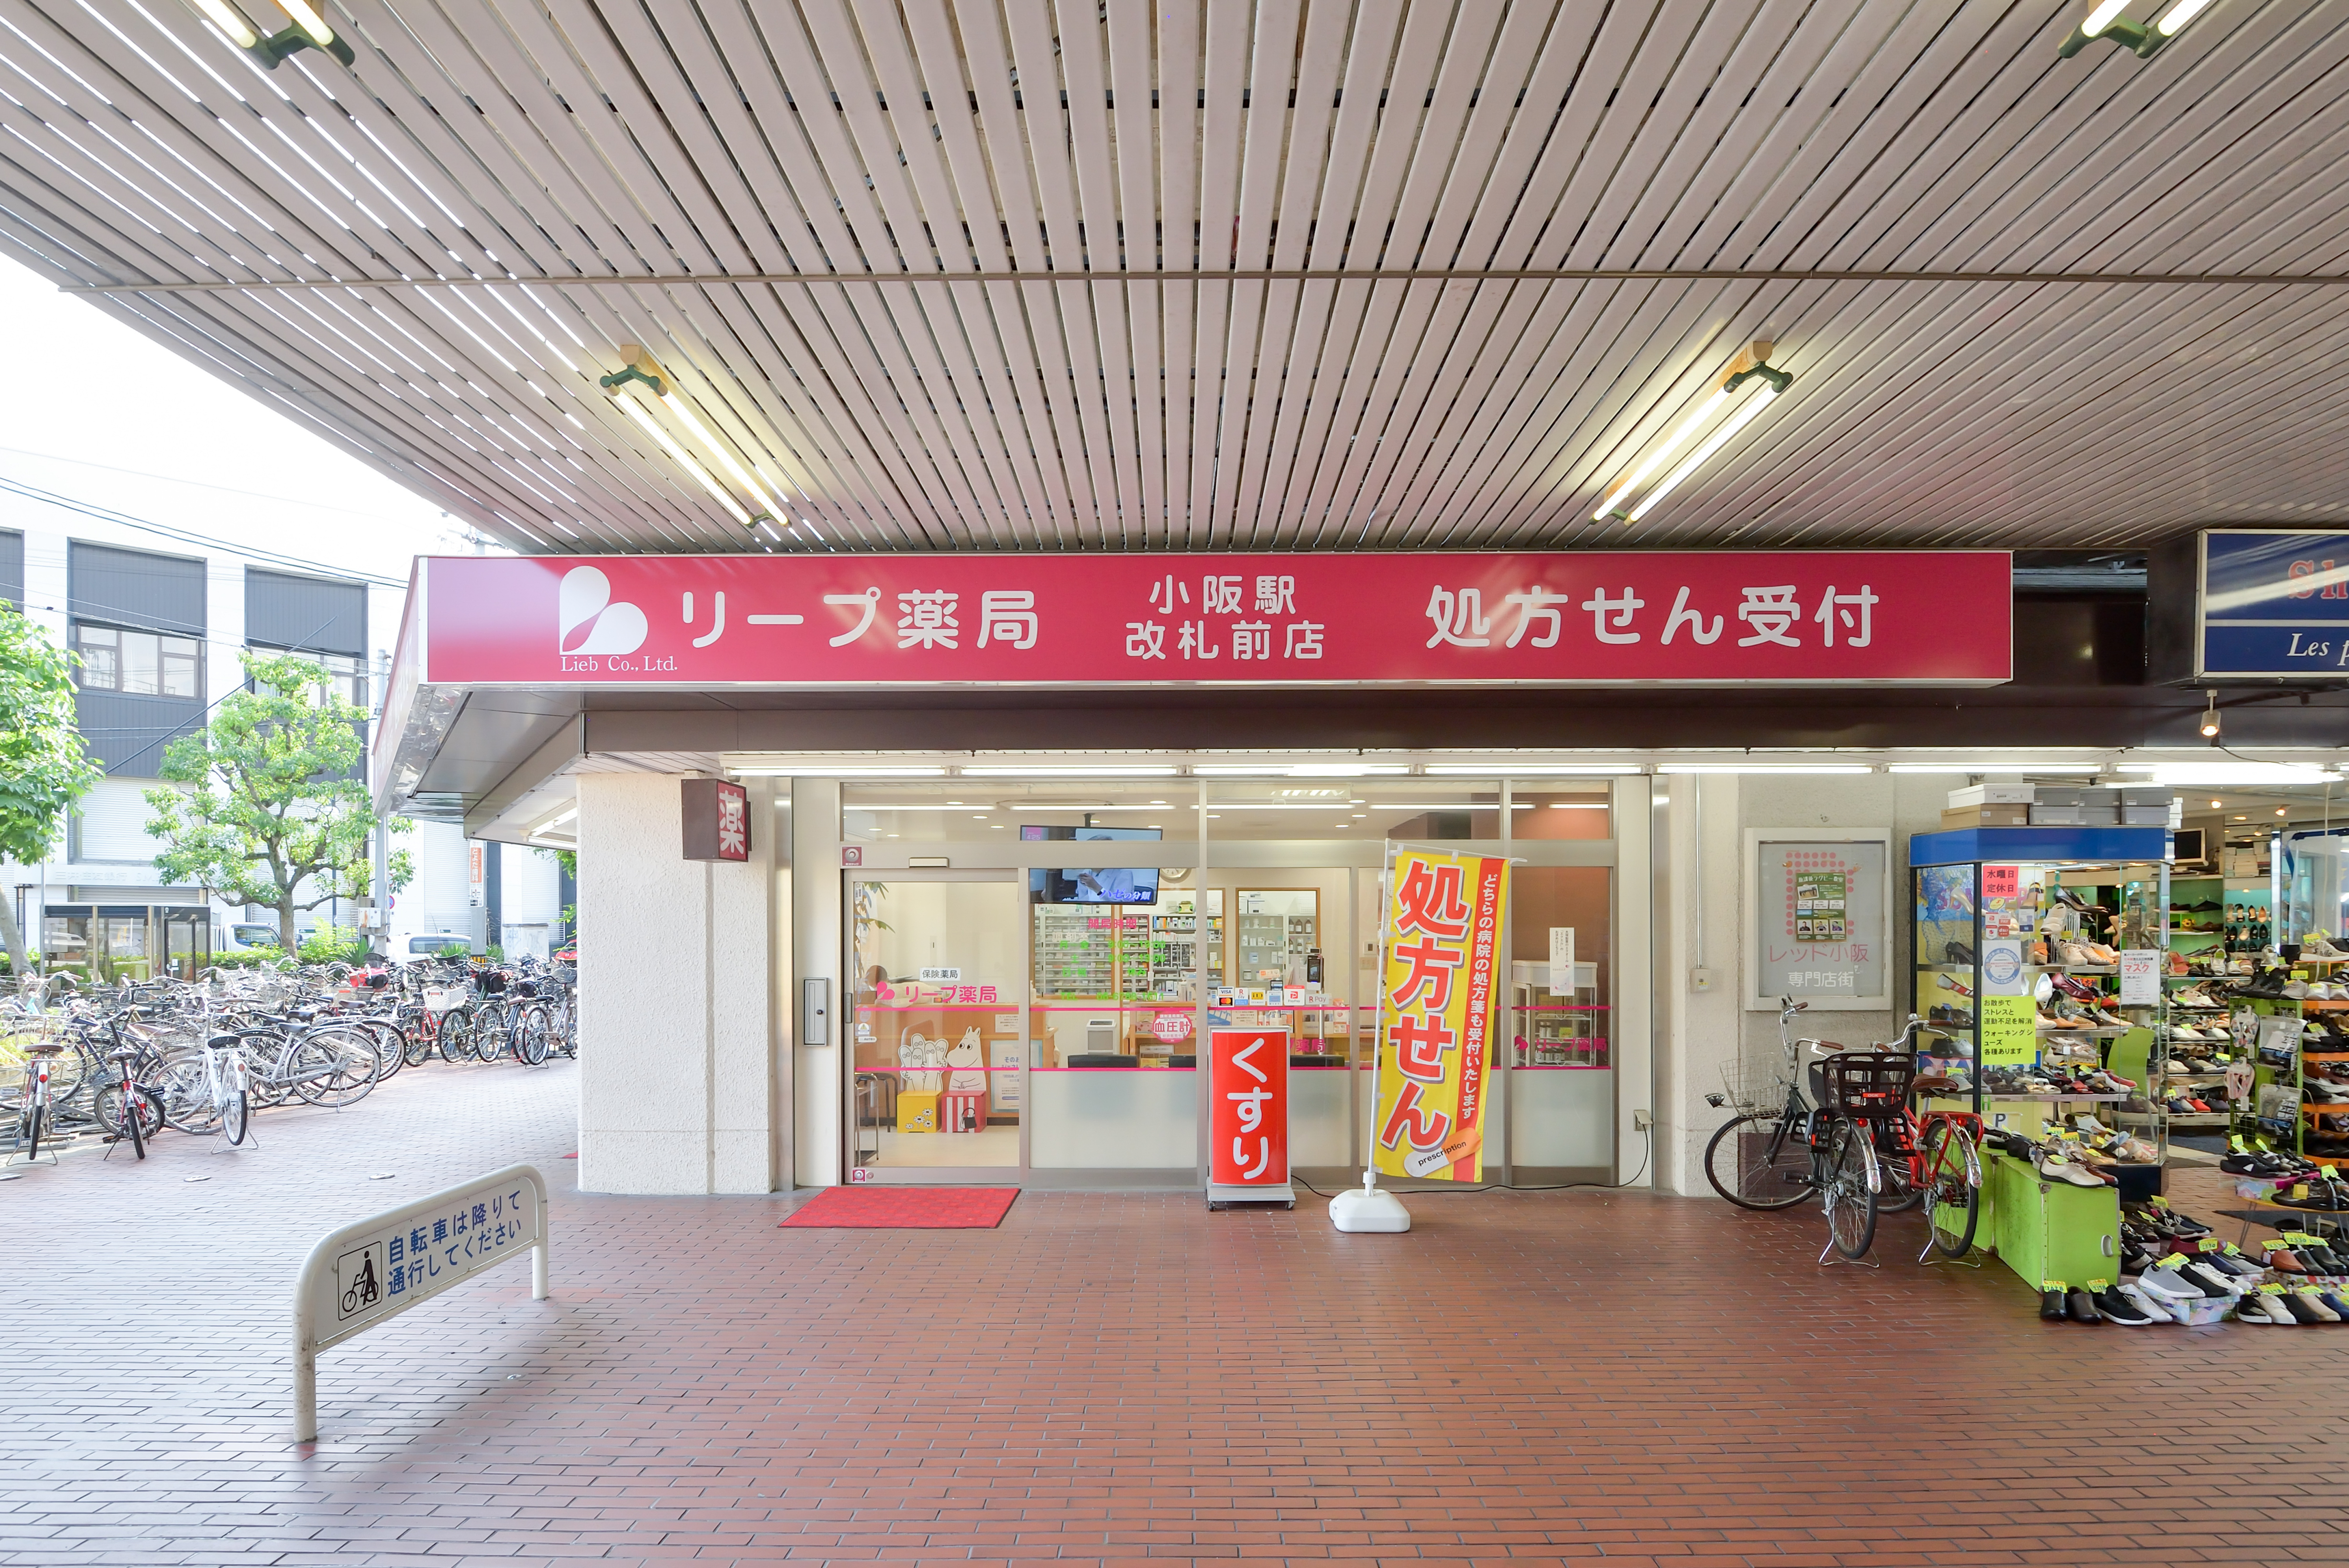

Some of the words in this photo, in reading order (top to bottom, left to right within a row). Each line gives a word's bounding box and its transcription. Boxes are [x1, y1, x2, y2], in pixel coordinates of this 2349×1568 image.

[1149, 575, 1296, 615] 小阪駅
[682, 586, 1038, 649] リープ薬局
[1425, 585, 1879, 649] 処方せん受付
[1125, 622, 1324, 660] 改札前店
[2287, 633, 2330, 656] Les
[561, 656, 598, 671] Lieb
[719, 789, 744, 855] 薬
[1987, 870, 2014, 879] 水曜日
[1099, 889, 1152, 901] ハゼの分類
[1986, 883, 2014, 893] 定休日
[1088, 918, 1137, 929] 開局時間
[1071, 954, 1079, 963] 土
[1770, 944, 1869, 962] レッド小阪
[922, 969, 958, 979] 保険薬局
[2124, 964, 2150, 972] マスク
[1787, 971, 1854, 987] 専門店街
[906, 985, 997, 1003] リープ薬局
[1060, 992, 1078, 1000] TEL
[1462, 874, 1497, 1120] どちらの病院の処方箋も受付いたします
[1380, 859, 1470, 1149] 処方せん
[1154, 1021, 1191, 1032] 血圧計
[1984, 1029, 2033, 1037] ウォーキングシ
[1536, 1037, 1607, 1052] リープ薬局
[1227, 1037, 1273, 1179] くすり
[1995, 1113, 2006, 1128] P
[1418, 1141, 1467, 1166] prescription
[388, 1190, 521, 1266] 自転車は降りて
[387, 1219, 522, 1298] 通行してください
